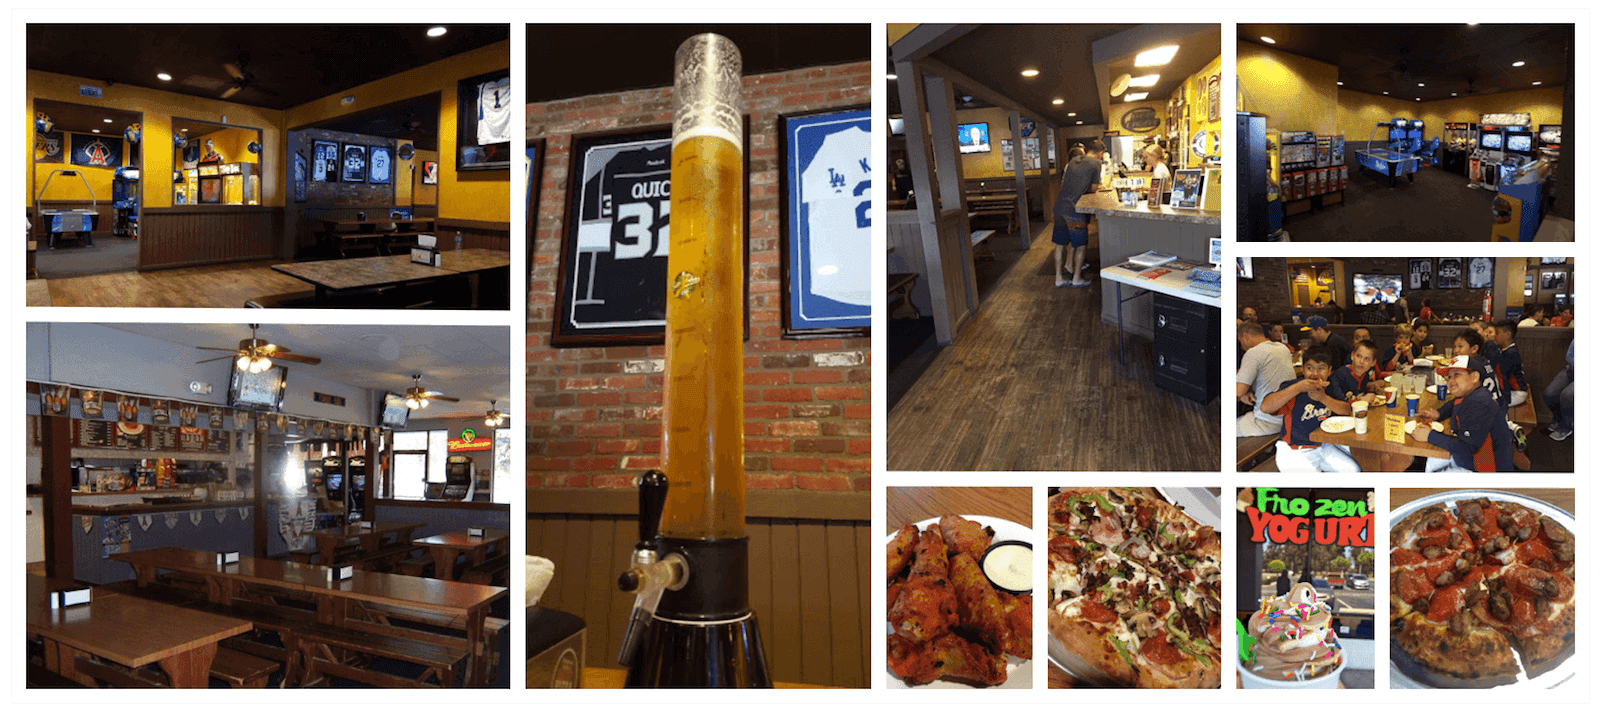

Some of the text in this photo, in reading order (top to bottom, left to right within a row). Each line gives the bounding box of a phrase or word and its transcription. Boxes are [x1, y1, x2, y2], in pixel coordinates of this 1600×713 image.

[493, 90, 502, 109] 1
[91, 143, 105, 164] A
[631, 180, 671, 199] QUIC
[1444, 267, 1456, 278] 32
[1476, 265, 1486, 274] 27
